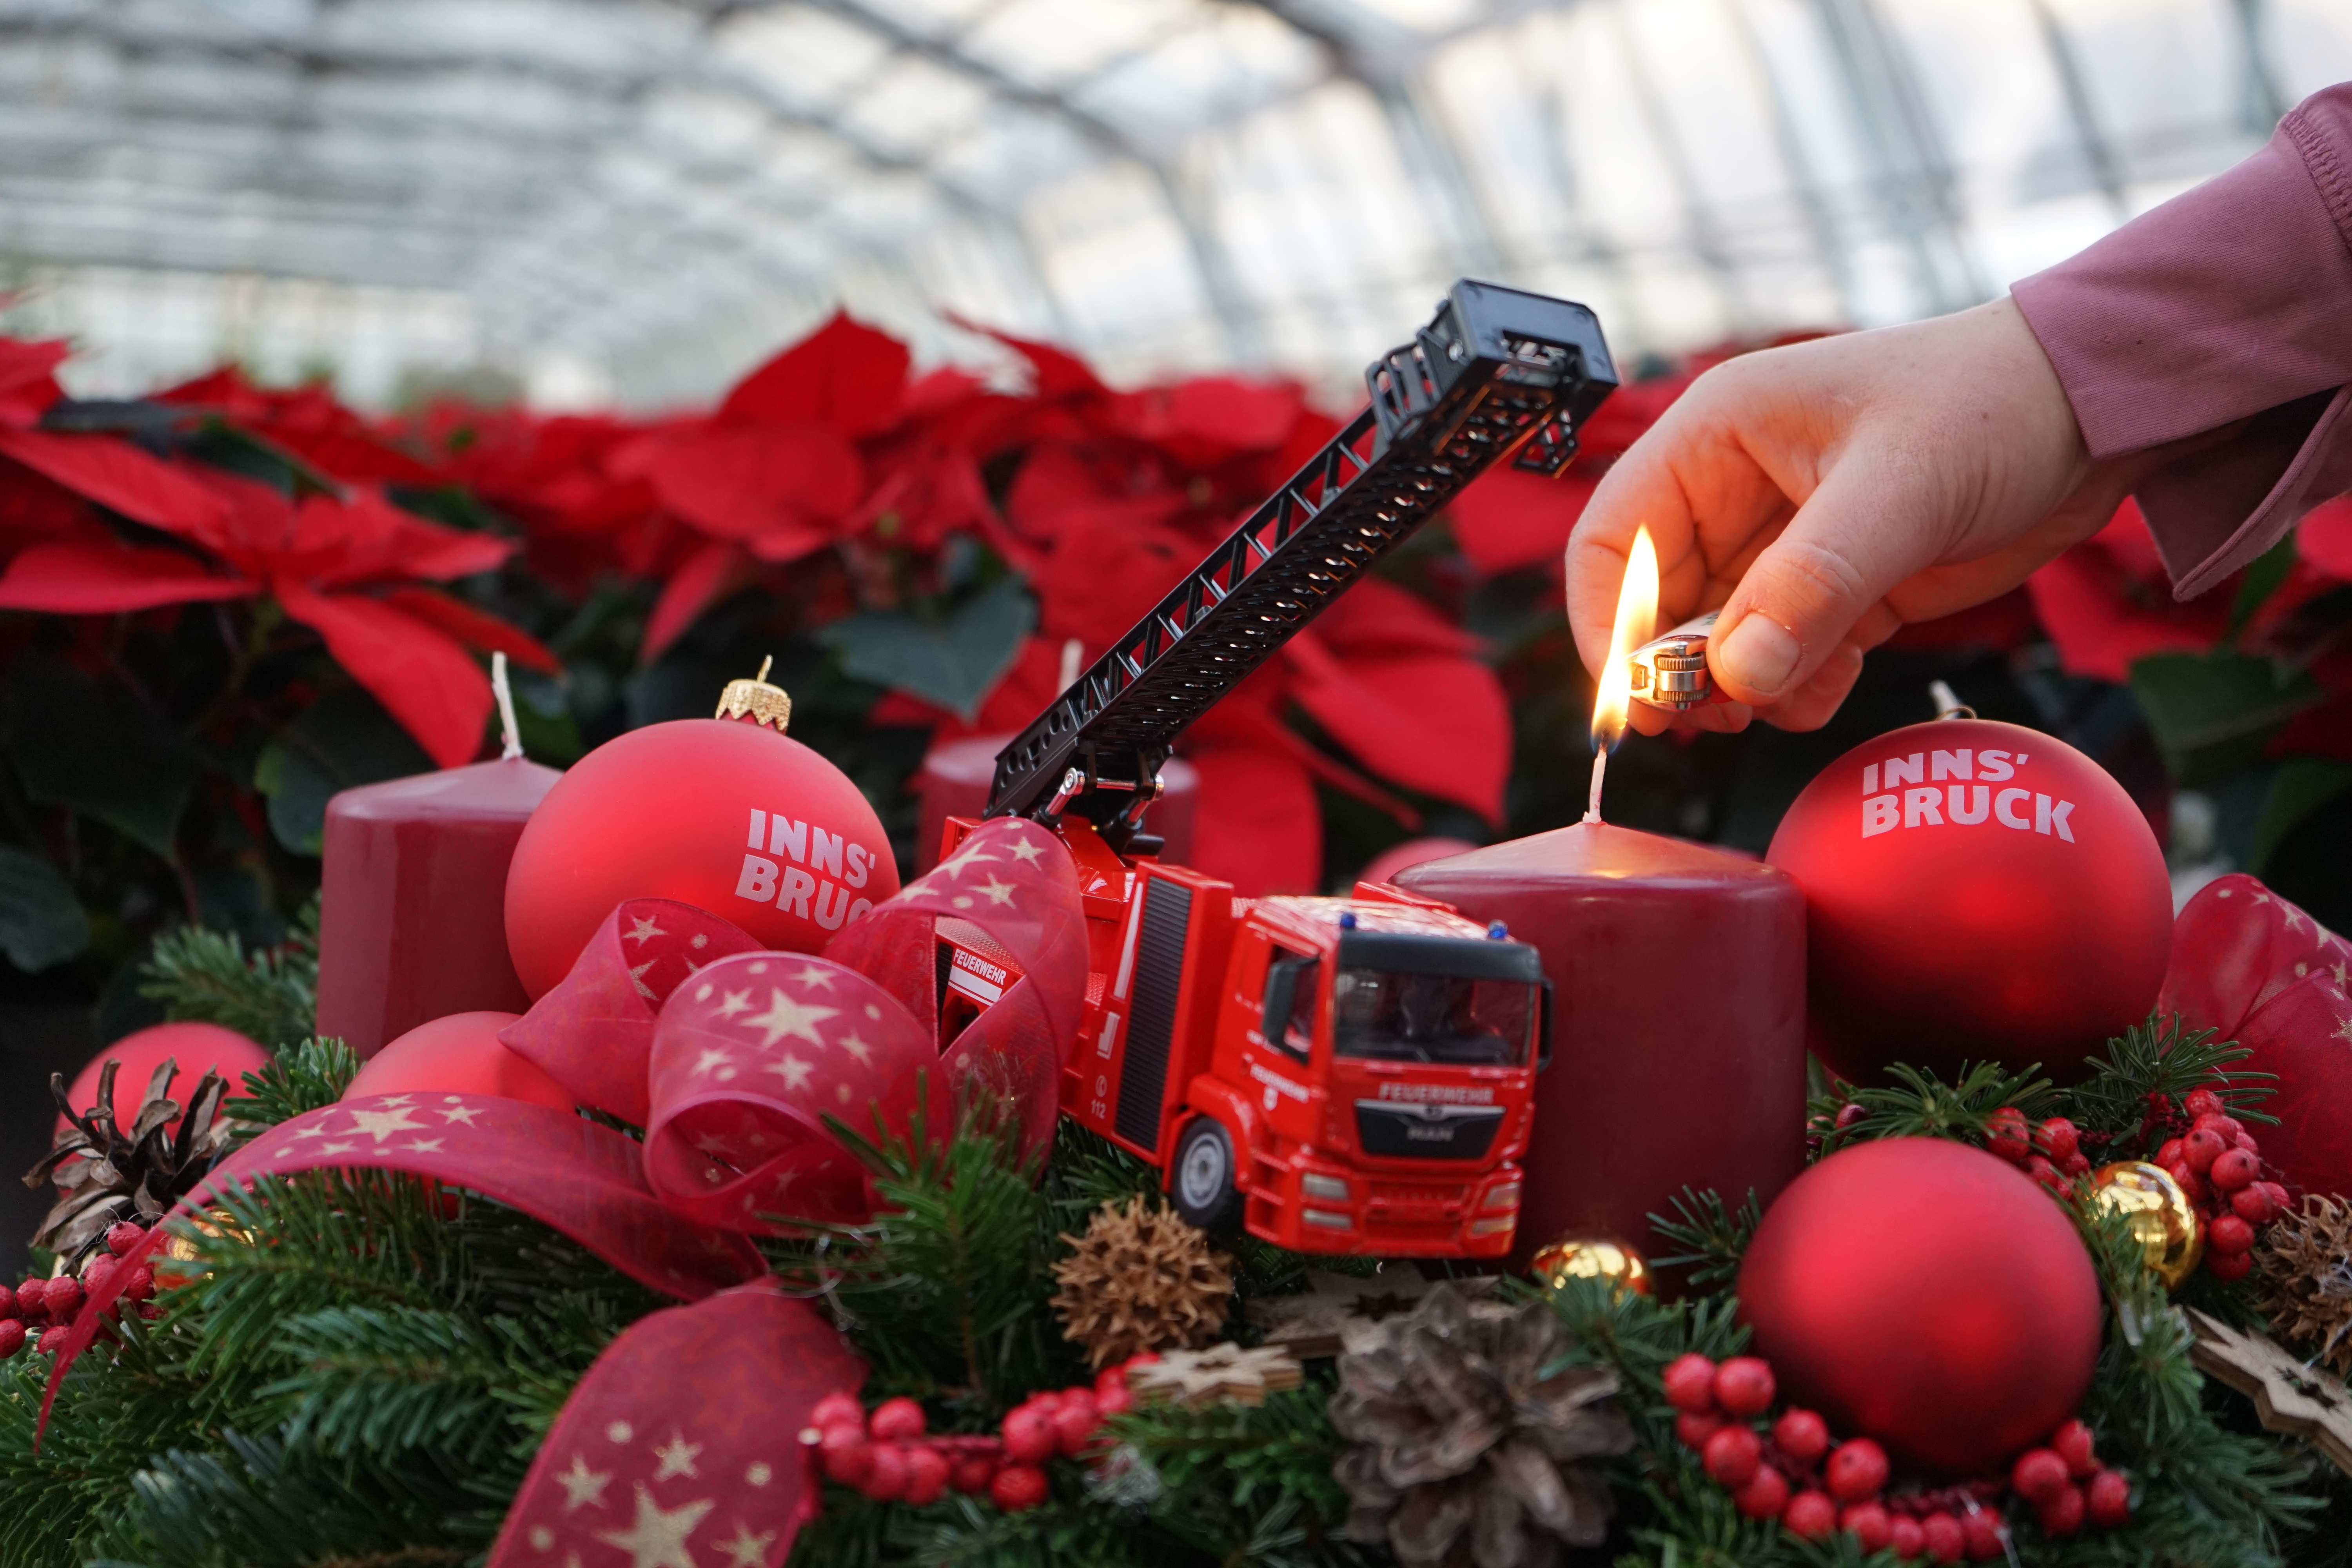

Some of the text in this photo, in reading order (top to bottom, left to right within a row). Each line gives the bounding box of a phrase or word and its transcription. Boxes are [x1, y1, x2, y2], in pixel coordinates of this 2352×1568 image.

[1863, 749, 2029, 795] INNS'
[1862, 785, 2075, 844] BRUCK
[747, 809, 876, 888] INNS'
[953, 948, 1007, 985] FEUERWEHR
[1091, 1099, 1106, 1120] 112
[1379, 1081, 1494, 1105] FEUERWEHR
